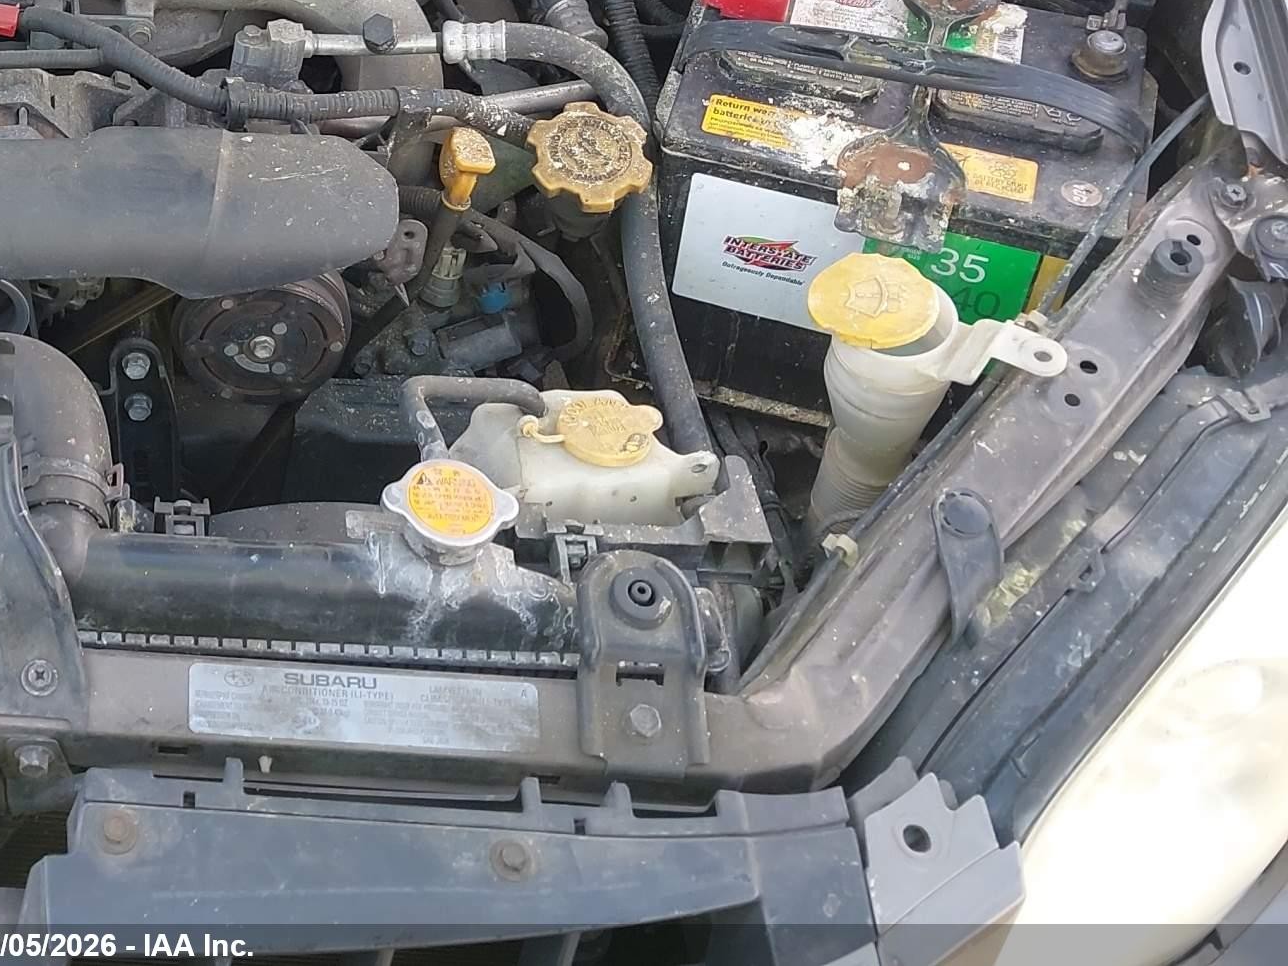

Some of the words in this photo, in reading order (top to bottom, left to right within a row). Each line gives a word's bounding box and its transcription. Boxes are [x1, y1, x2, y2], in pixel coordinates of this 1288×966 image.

[715, 98, 751, 112] Return
[723, 235, 816, 265] INTERSTATE
[723, 245, 807, 271] BATTERIES
[721, 261, 764, 277] Outrageously
[765, 272, 804, 286] Dependable
[930, 247, 990, 283] 35
[280, 687, 349, 700] CONDITIONER
[284, 672, 377, 690] SUBARU
